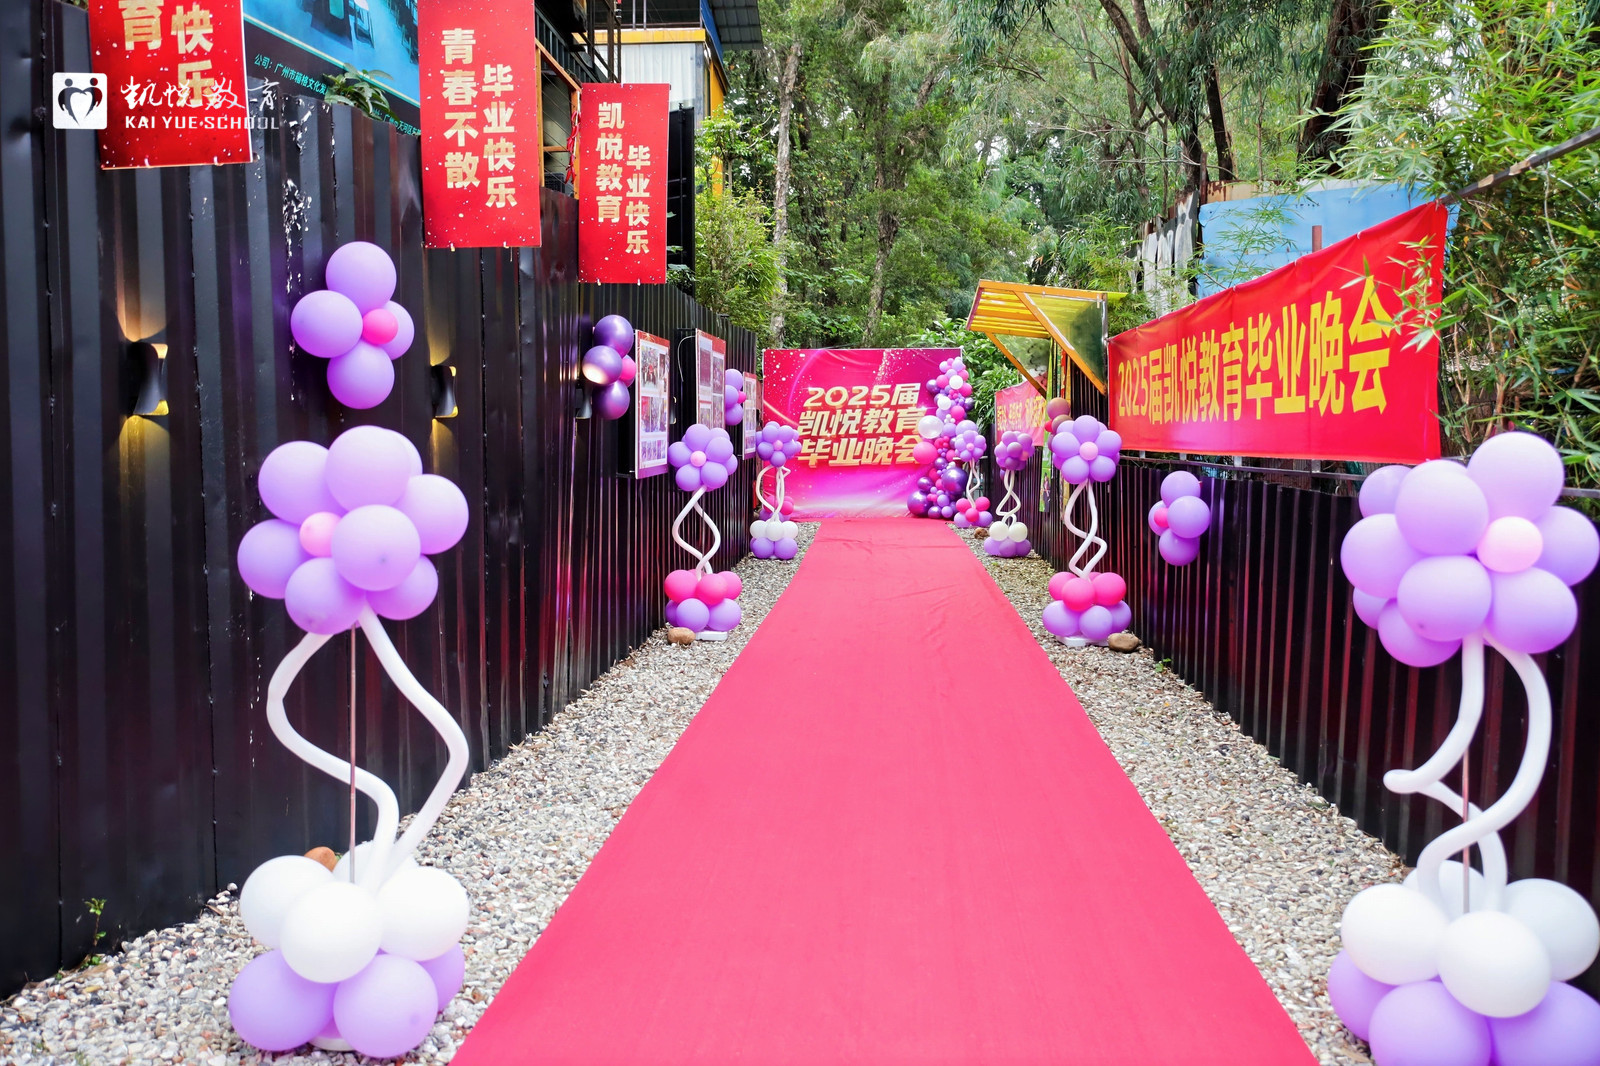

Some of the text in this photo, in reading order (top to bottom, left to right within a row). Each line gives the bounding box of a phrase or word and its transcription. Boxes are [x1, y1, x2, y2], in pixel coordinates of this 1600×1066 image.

[118, 0, 165, 50] 育
[170, 4, 215, 108] 快乐
[441, 28, 480, 189] 青春不散
[482, 63, 517, 209] 毕业快乐
[595, 101, 625, 223] 凯悦教育
[625, 145, 650, 254] 毕业快乐
[803, 382, 921, 408] 2025届
[1117, 275, 1393, 426] 2025届凯悦教育毕业晚会
[797, 406, 927, 438] 凯悦教育
[797, 434, 924, 469] 毕业晚会
